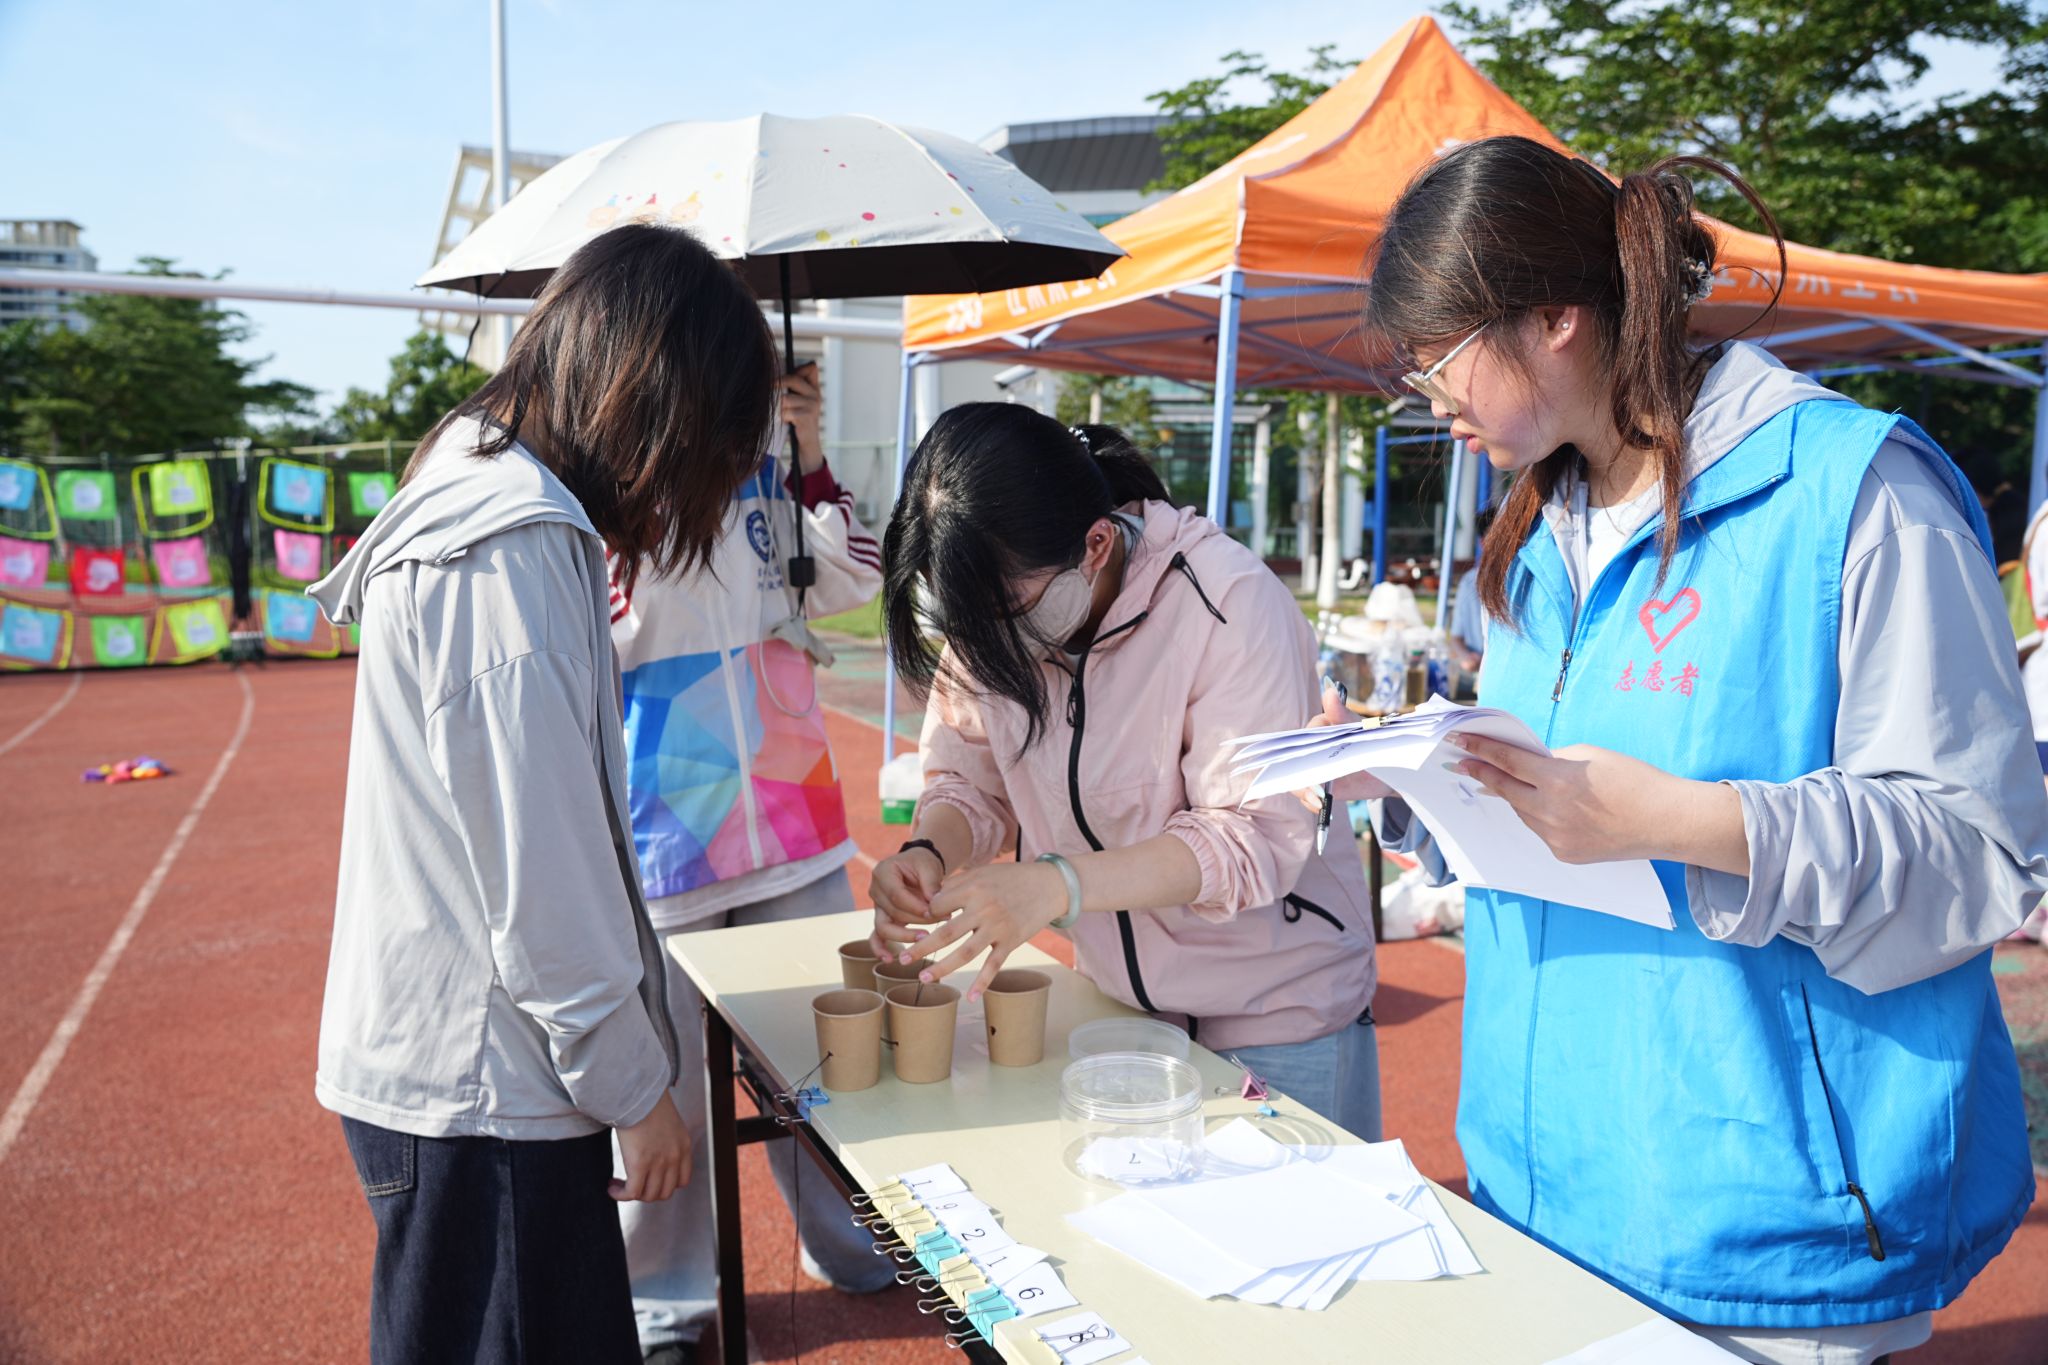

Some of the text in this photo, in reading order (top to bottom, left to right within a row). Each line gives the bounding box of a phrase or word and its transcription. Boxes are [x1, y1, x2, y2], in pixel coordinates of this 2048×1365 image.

[1615, 659, 1699, 697] 志愿者
[961, 1227, 986, 1241] 2
[1018, 1287, 1044, 1300] 6
